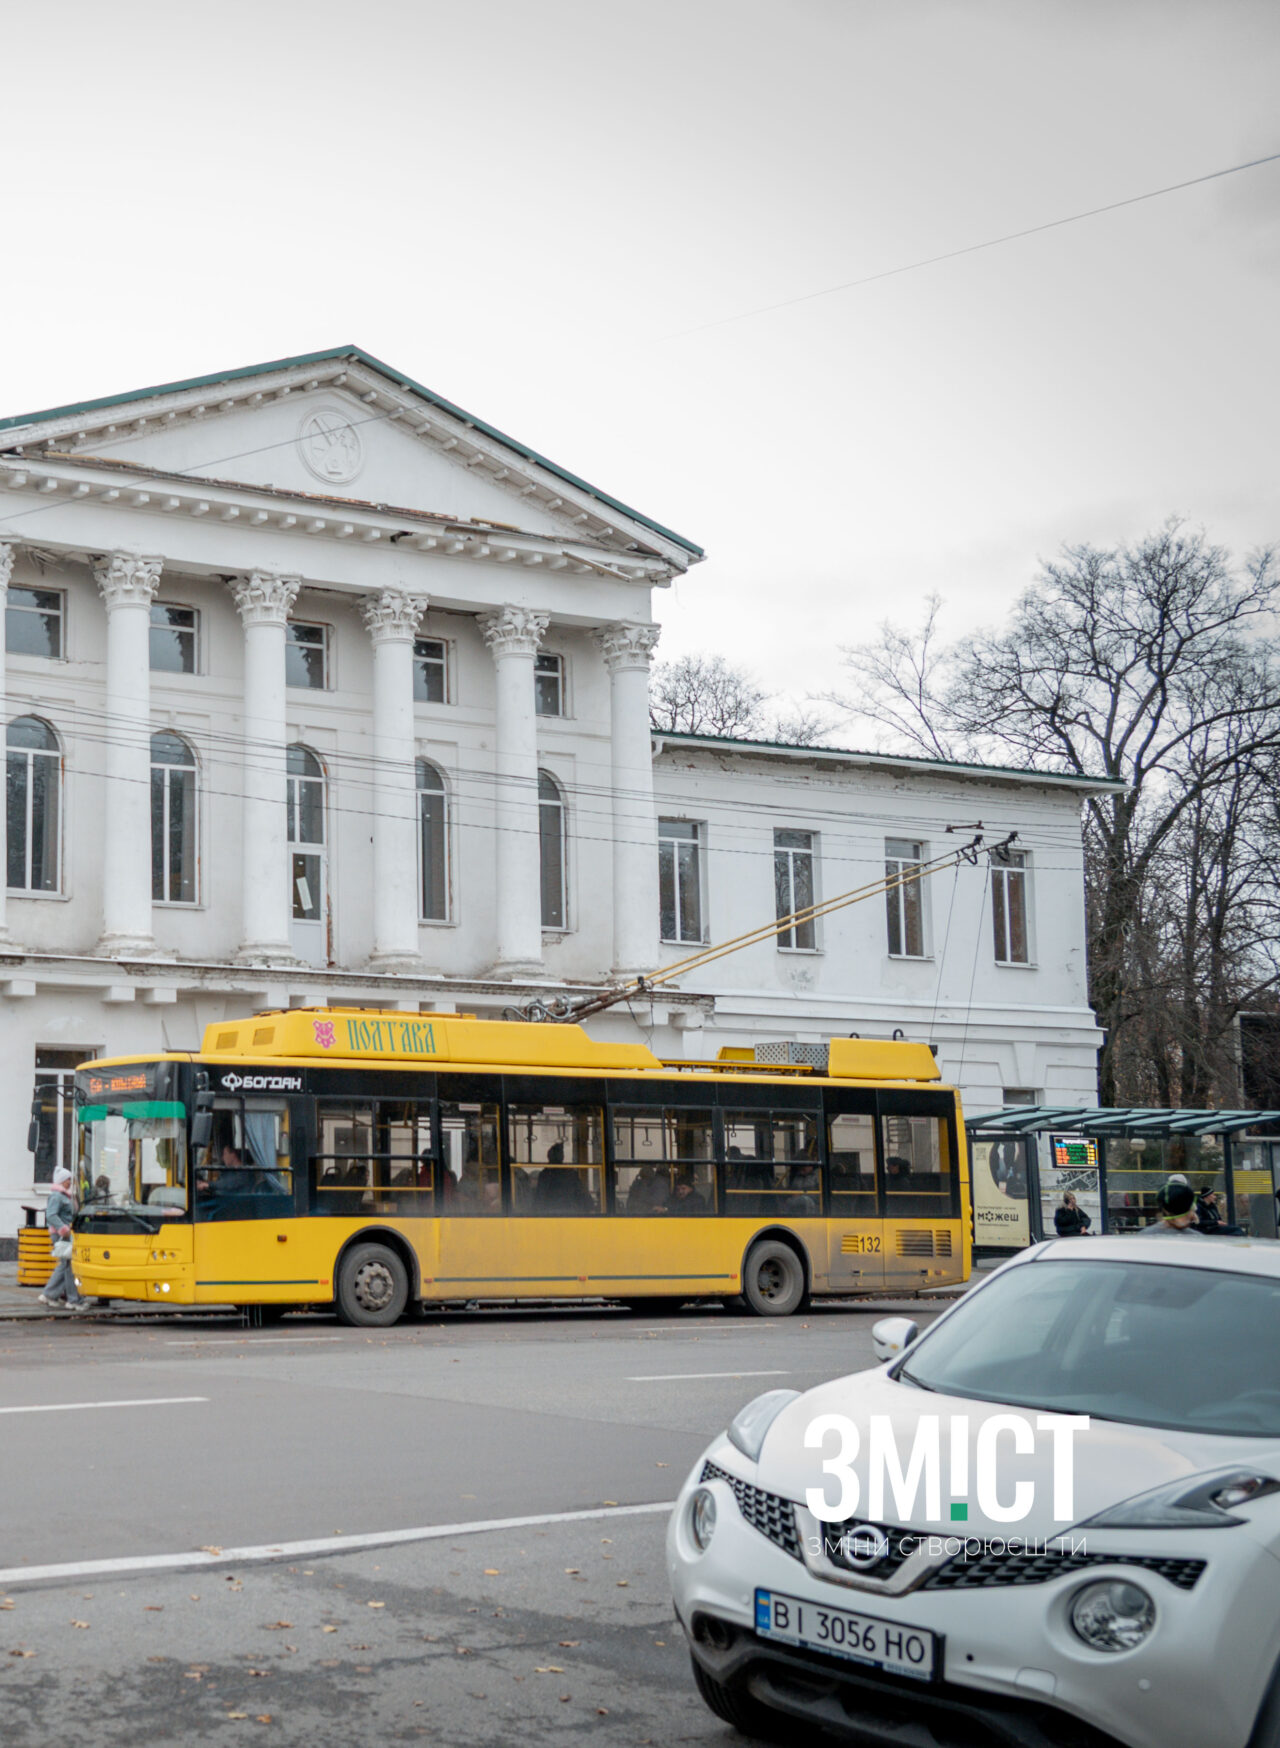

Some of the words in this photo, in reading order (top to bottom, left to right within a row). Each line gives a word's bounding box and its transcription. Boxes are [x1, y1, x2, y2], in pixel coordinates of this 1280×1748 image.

[347, 1019, 436, 1053] ПОЛТАВА
[242, 1075, 302, 1090] БОГДАН
[860, 1236, 881, 1253] 132
[817, 1612, 876, 1652] 3056
